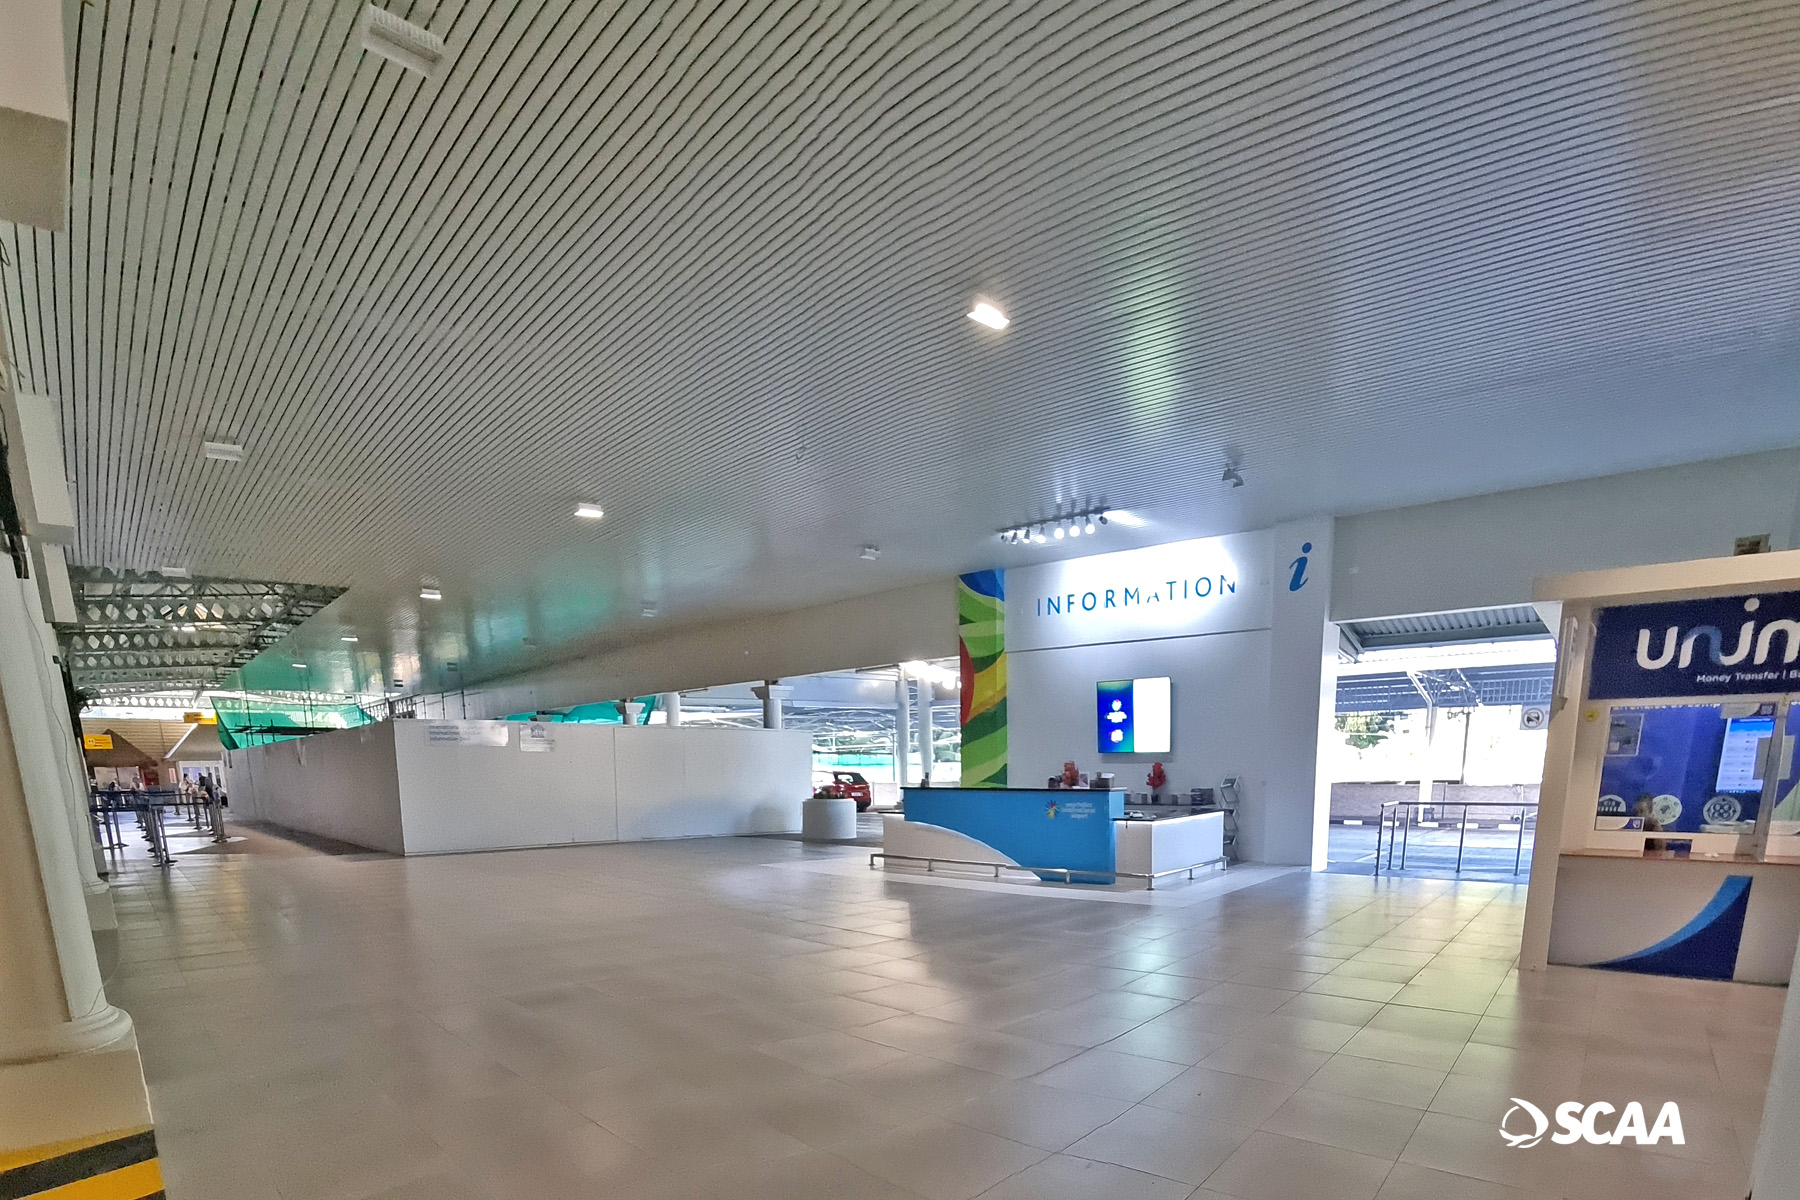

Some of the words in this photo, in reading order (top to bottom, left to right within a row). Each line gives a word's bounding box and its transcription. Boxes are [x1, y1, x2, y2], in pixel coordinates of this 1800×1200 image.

[1036, 574, 1236, 617] INFORMATION
[1696, 674, 1732, 684] Money
[1735, 671, 1780, 681] Transfer
